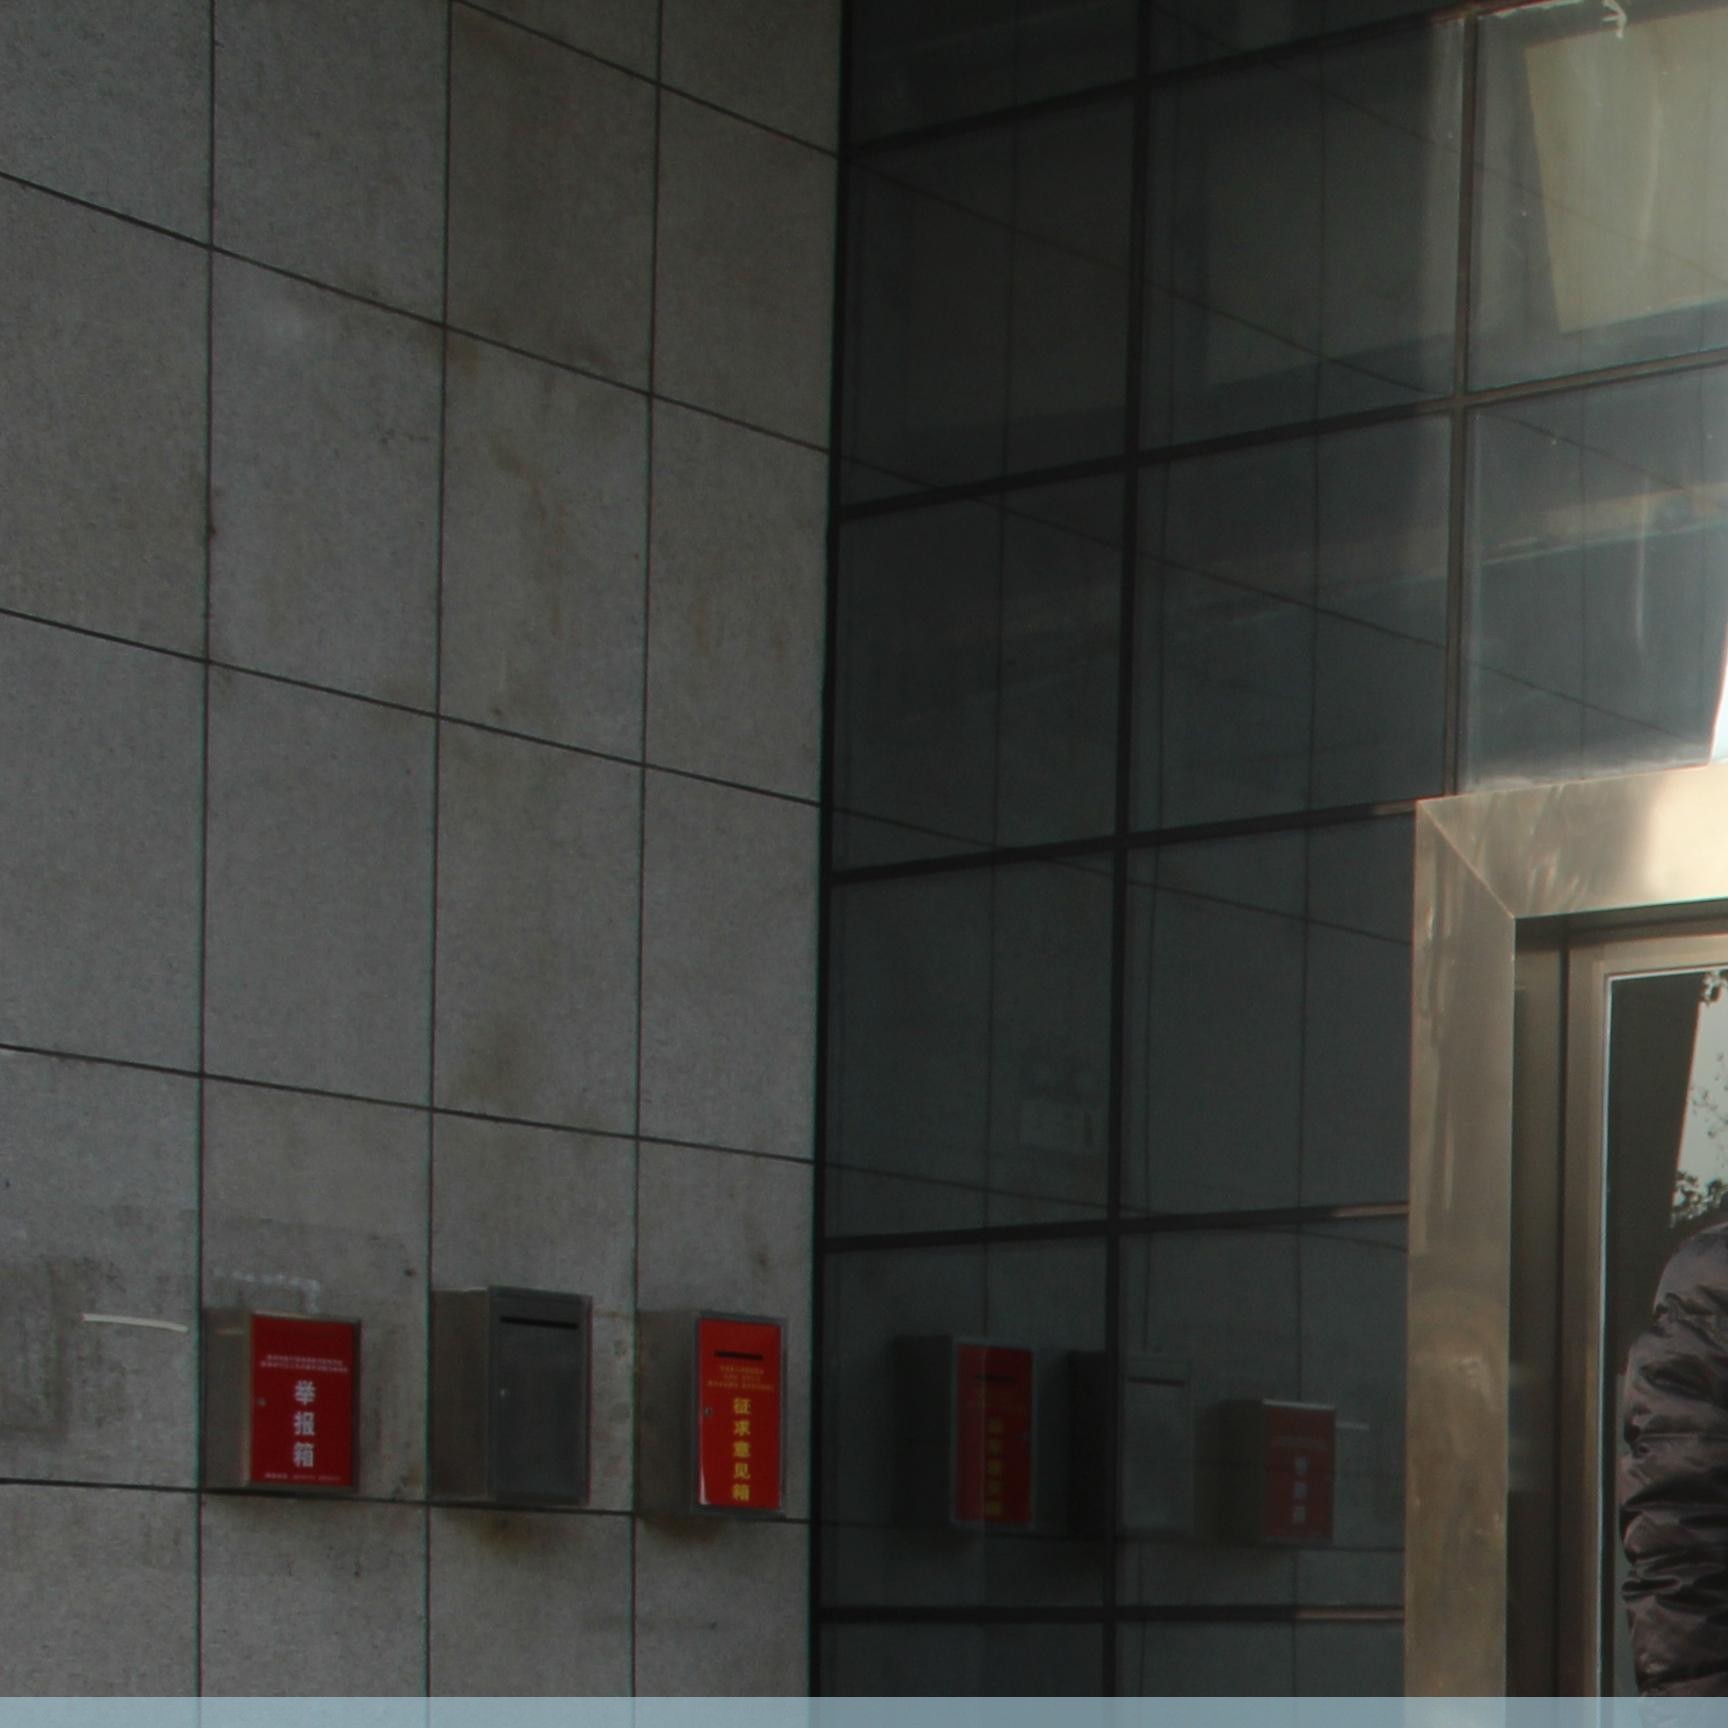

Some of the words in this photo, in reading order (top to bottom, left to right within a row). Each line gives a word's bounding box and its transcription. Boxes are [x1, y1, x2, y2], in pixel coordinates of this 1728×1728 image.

[293, 1380, 316, 1468] 举报箱
[732, 1398, 751, 1501] 征求意见箱
